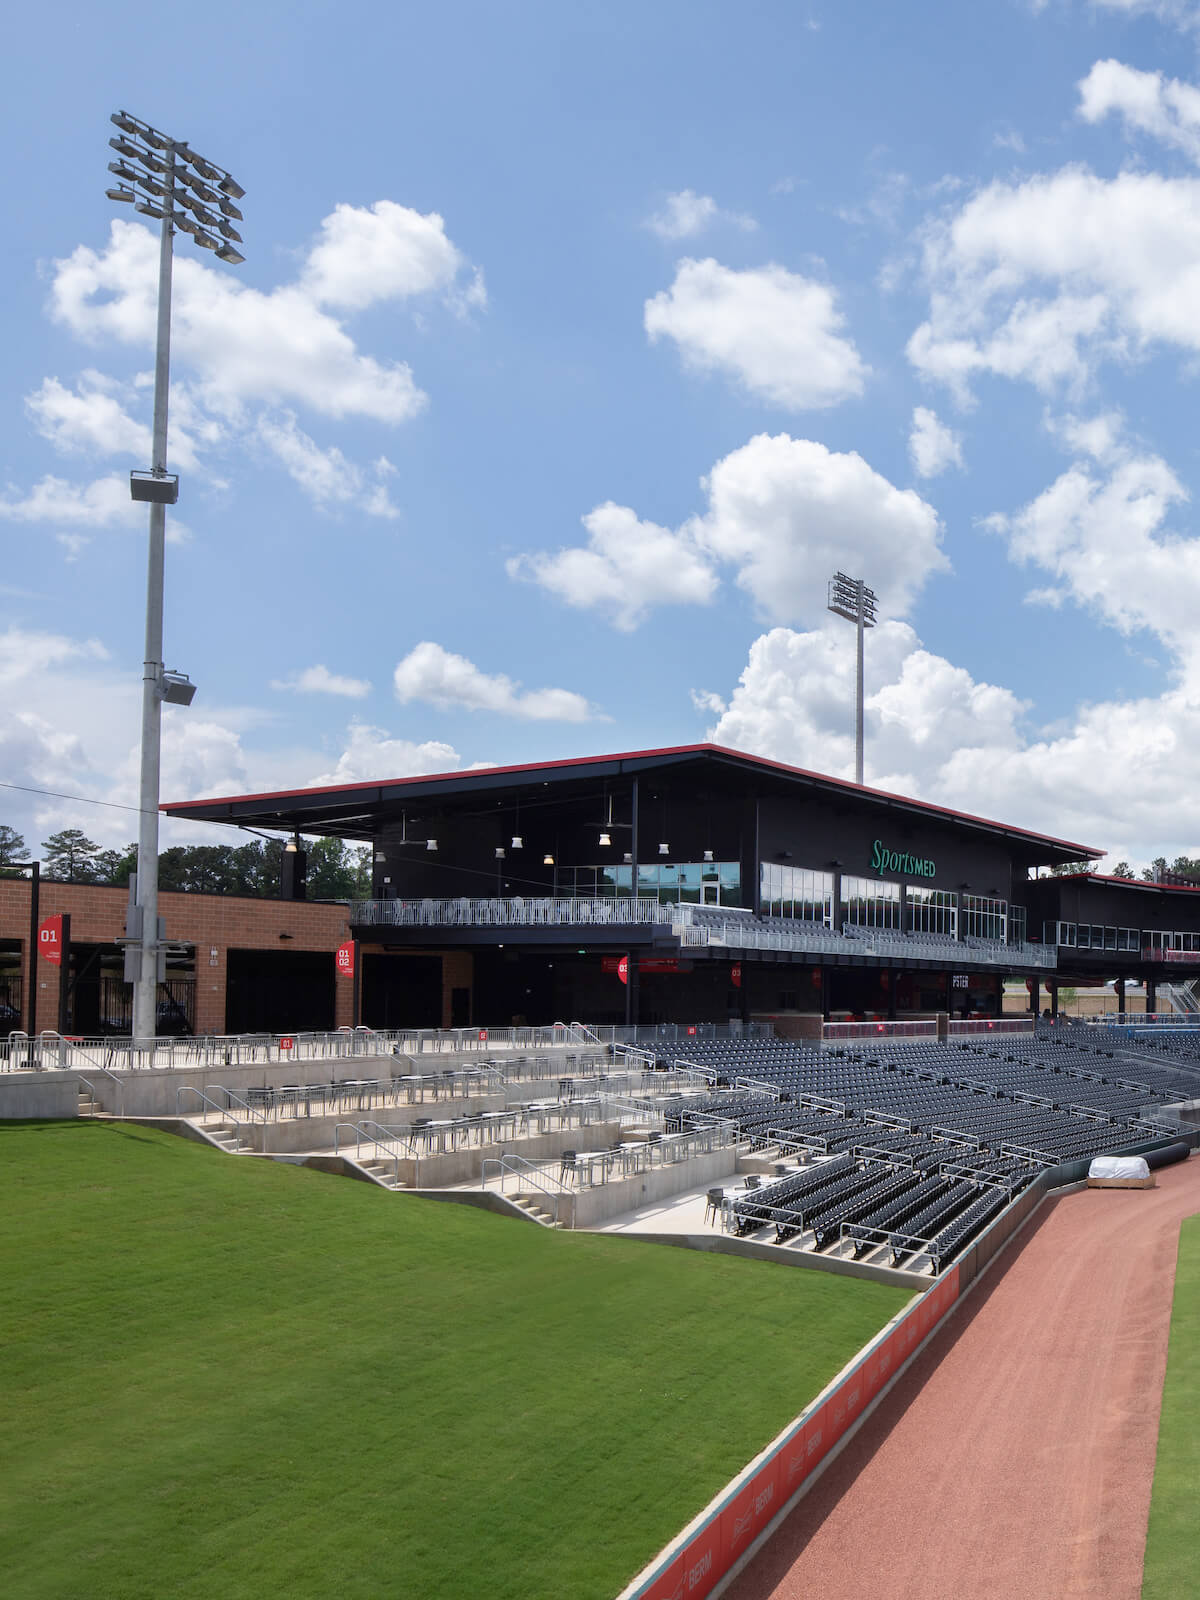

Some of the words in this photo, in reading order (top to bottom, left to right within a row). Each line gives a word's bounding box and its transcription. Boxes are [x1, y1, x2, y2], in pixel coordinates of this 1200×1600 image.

[40, 930, 57, 942] 01
[339, 949, 350, 958] 01
[339, 958, 350, 967] 02
[755, 1481, 775, 1516] BERM
[688, 1548, 713, 1592] BERM
